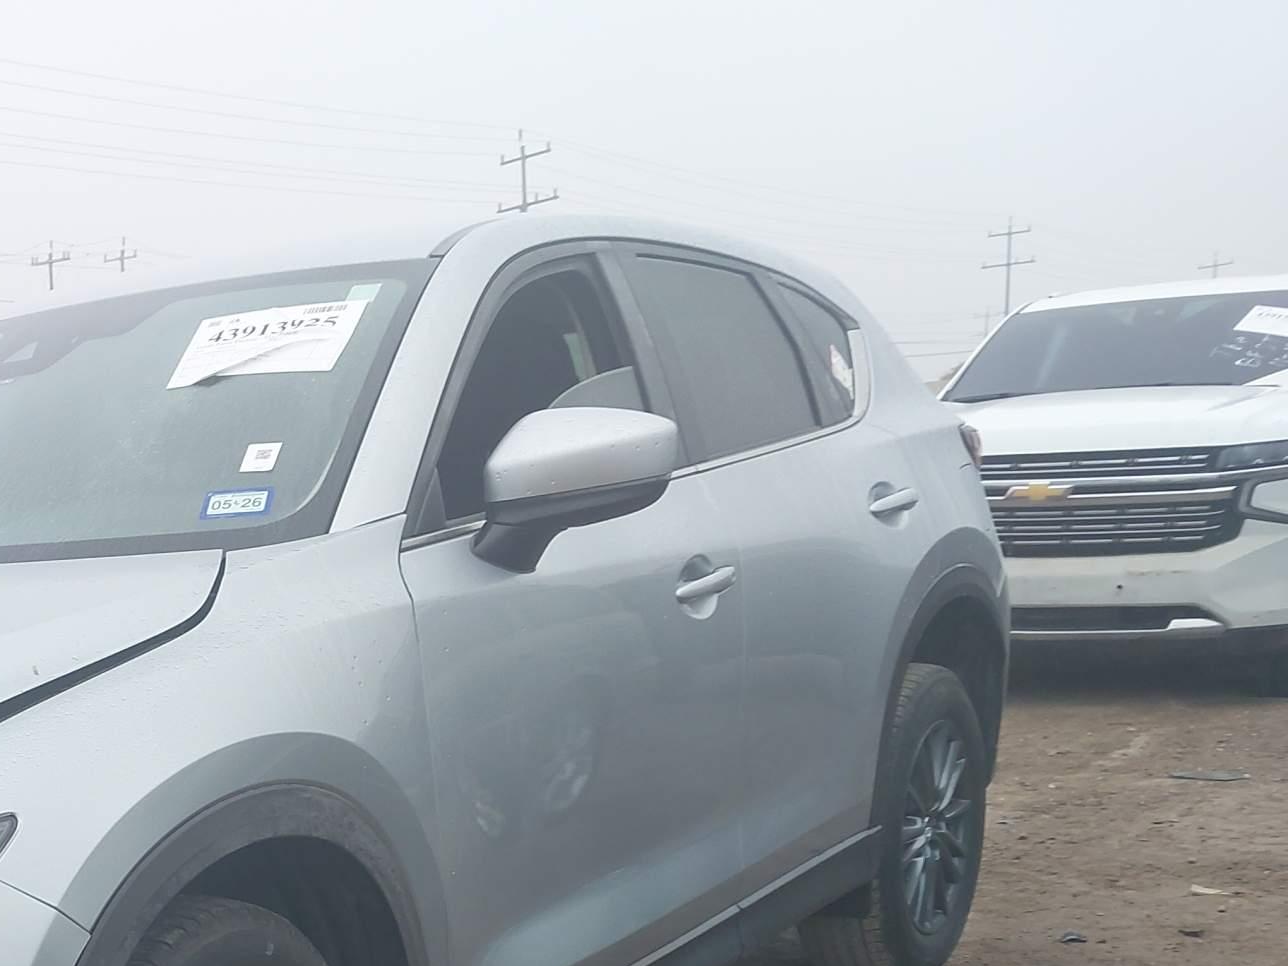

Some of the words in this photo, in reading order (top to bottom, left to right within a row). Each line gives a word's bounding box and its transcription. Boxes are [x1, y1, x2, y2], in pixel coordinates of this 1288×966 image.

[208, 315, 340, 343] 43913925
[211, 499, 233, 511] 05
[240, 496, 263, 508] 26
